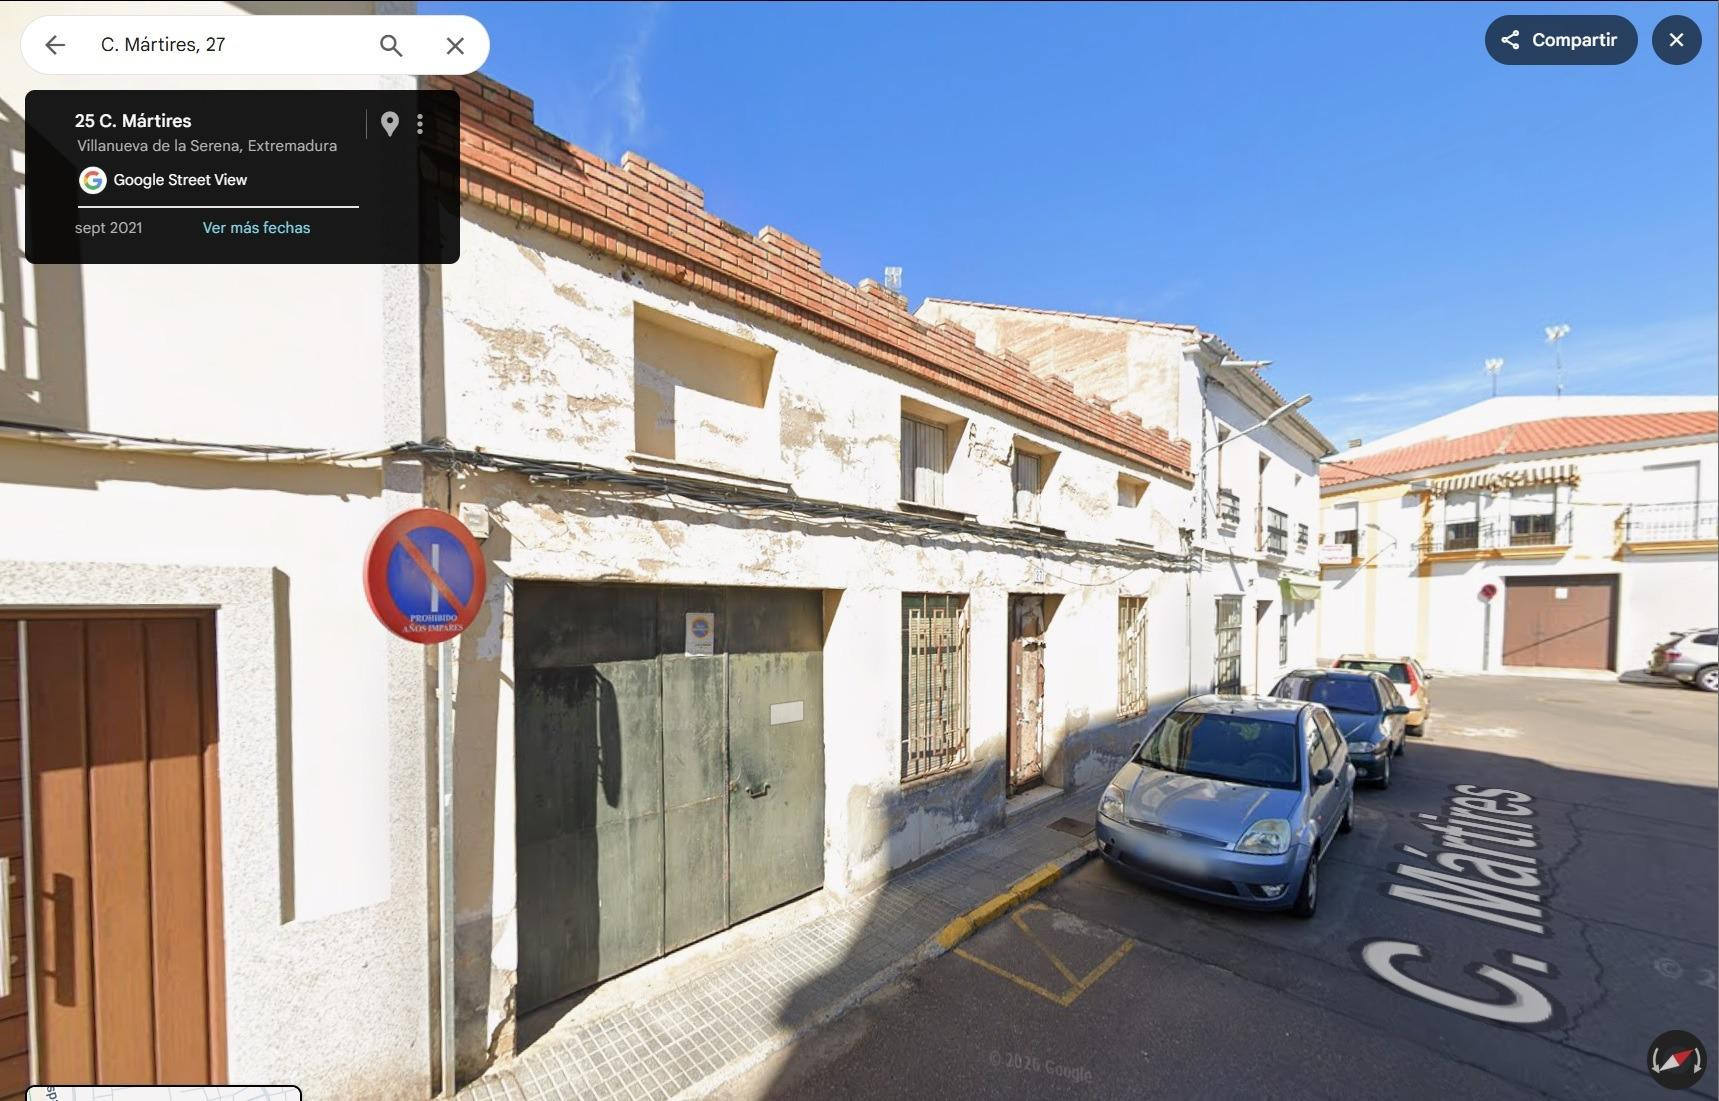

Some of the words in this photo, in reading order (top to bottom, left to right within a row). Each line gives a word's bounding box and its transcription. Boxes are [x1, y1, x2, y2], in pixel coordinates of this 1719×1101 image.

[410, 614, 458, 623] PROHIBIDO
[402, 624, 427, 633] AÑOS
[428, 624, 464, 632] IMPARES
